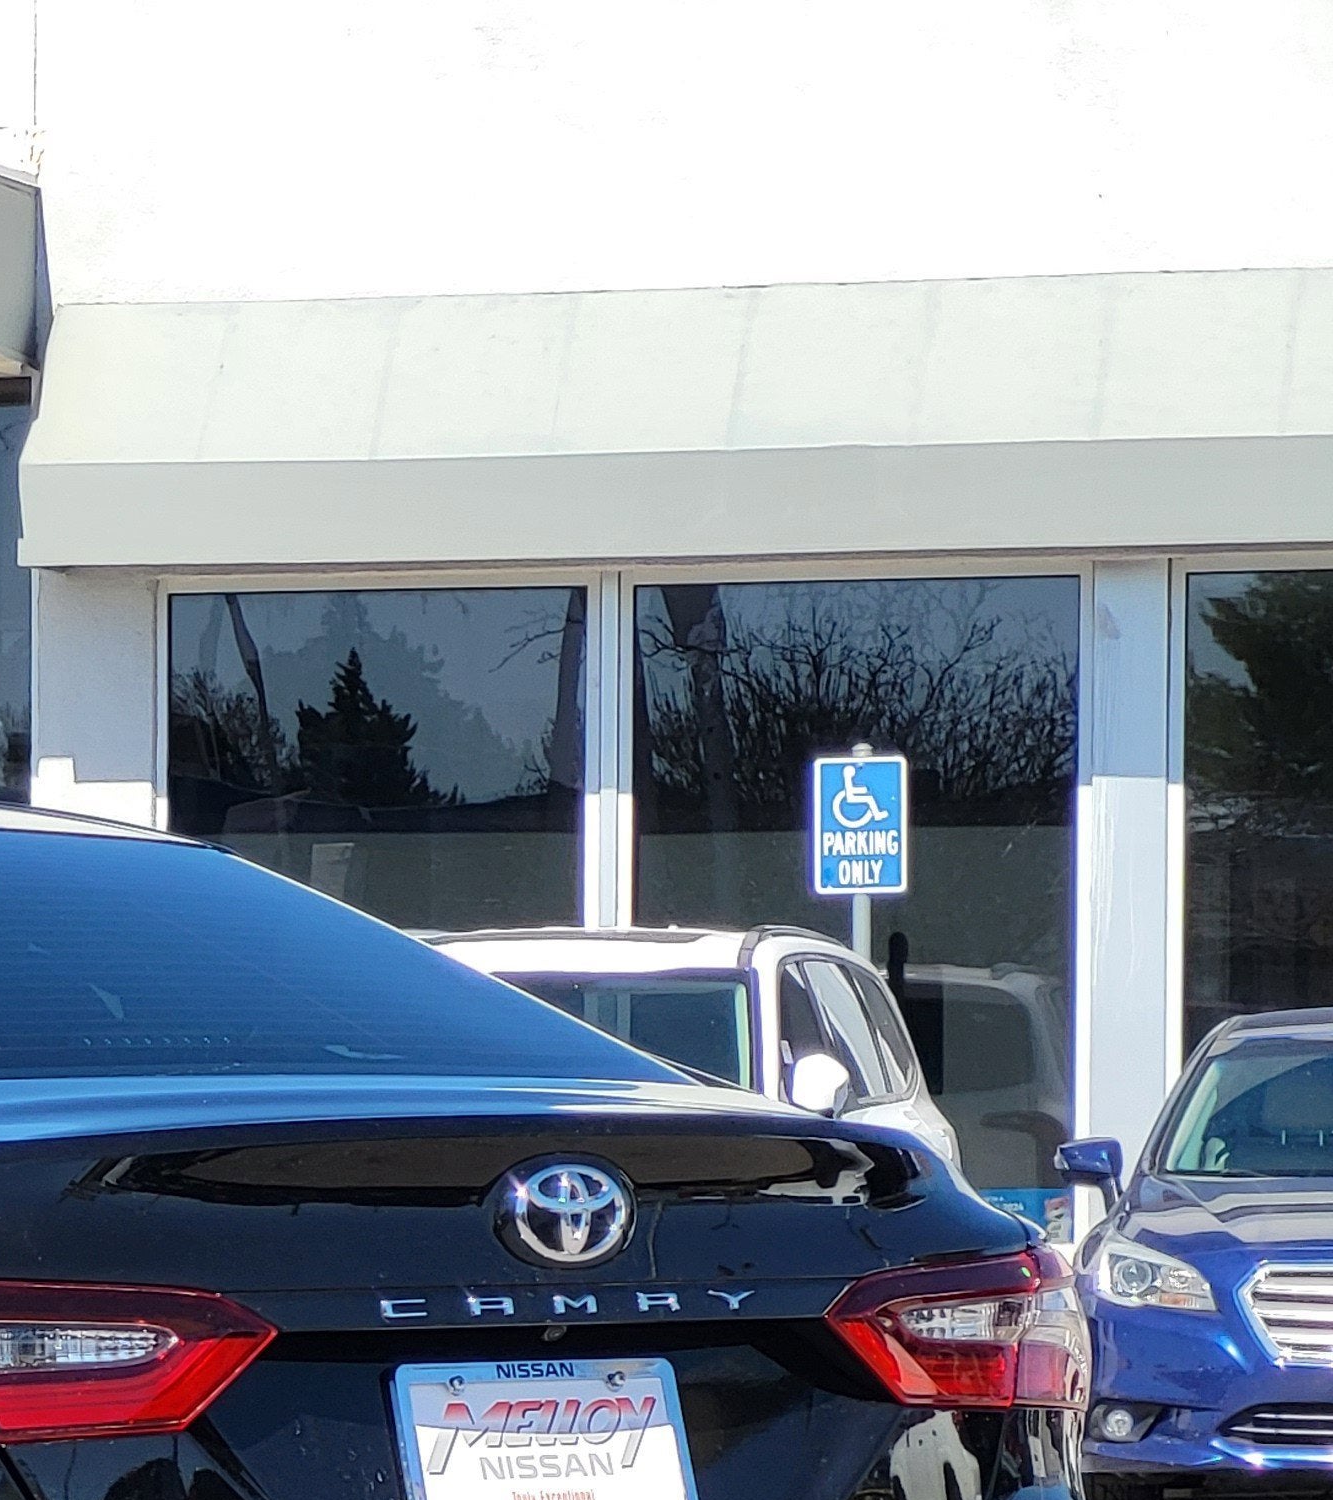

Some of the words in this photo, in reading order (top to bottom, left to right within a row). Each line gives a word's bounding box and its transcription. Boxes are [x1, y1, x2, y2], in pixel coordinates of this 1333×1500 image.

[823, 830, 900, 856] PARKING
[838, 859, 883, 885] ONLY
[379, 1289, 756, 1319] CAMRY
[496, 1362, 575, 1379] NISSAN
[427, 1396, 657, 1475] MELLOY
[479, 1452, 614, 1480] NISSAN
